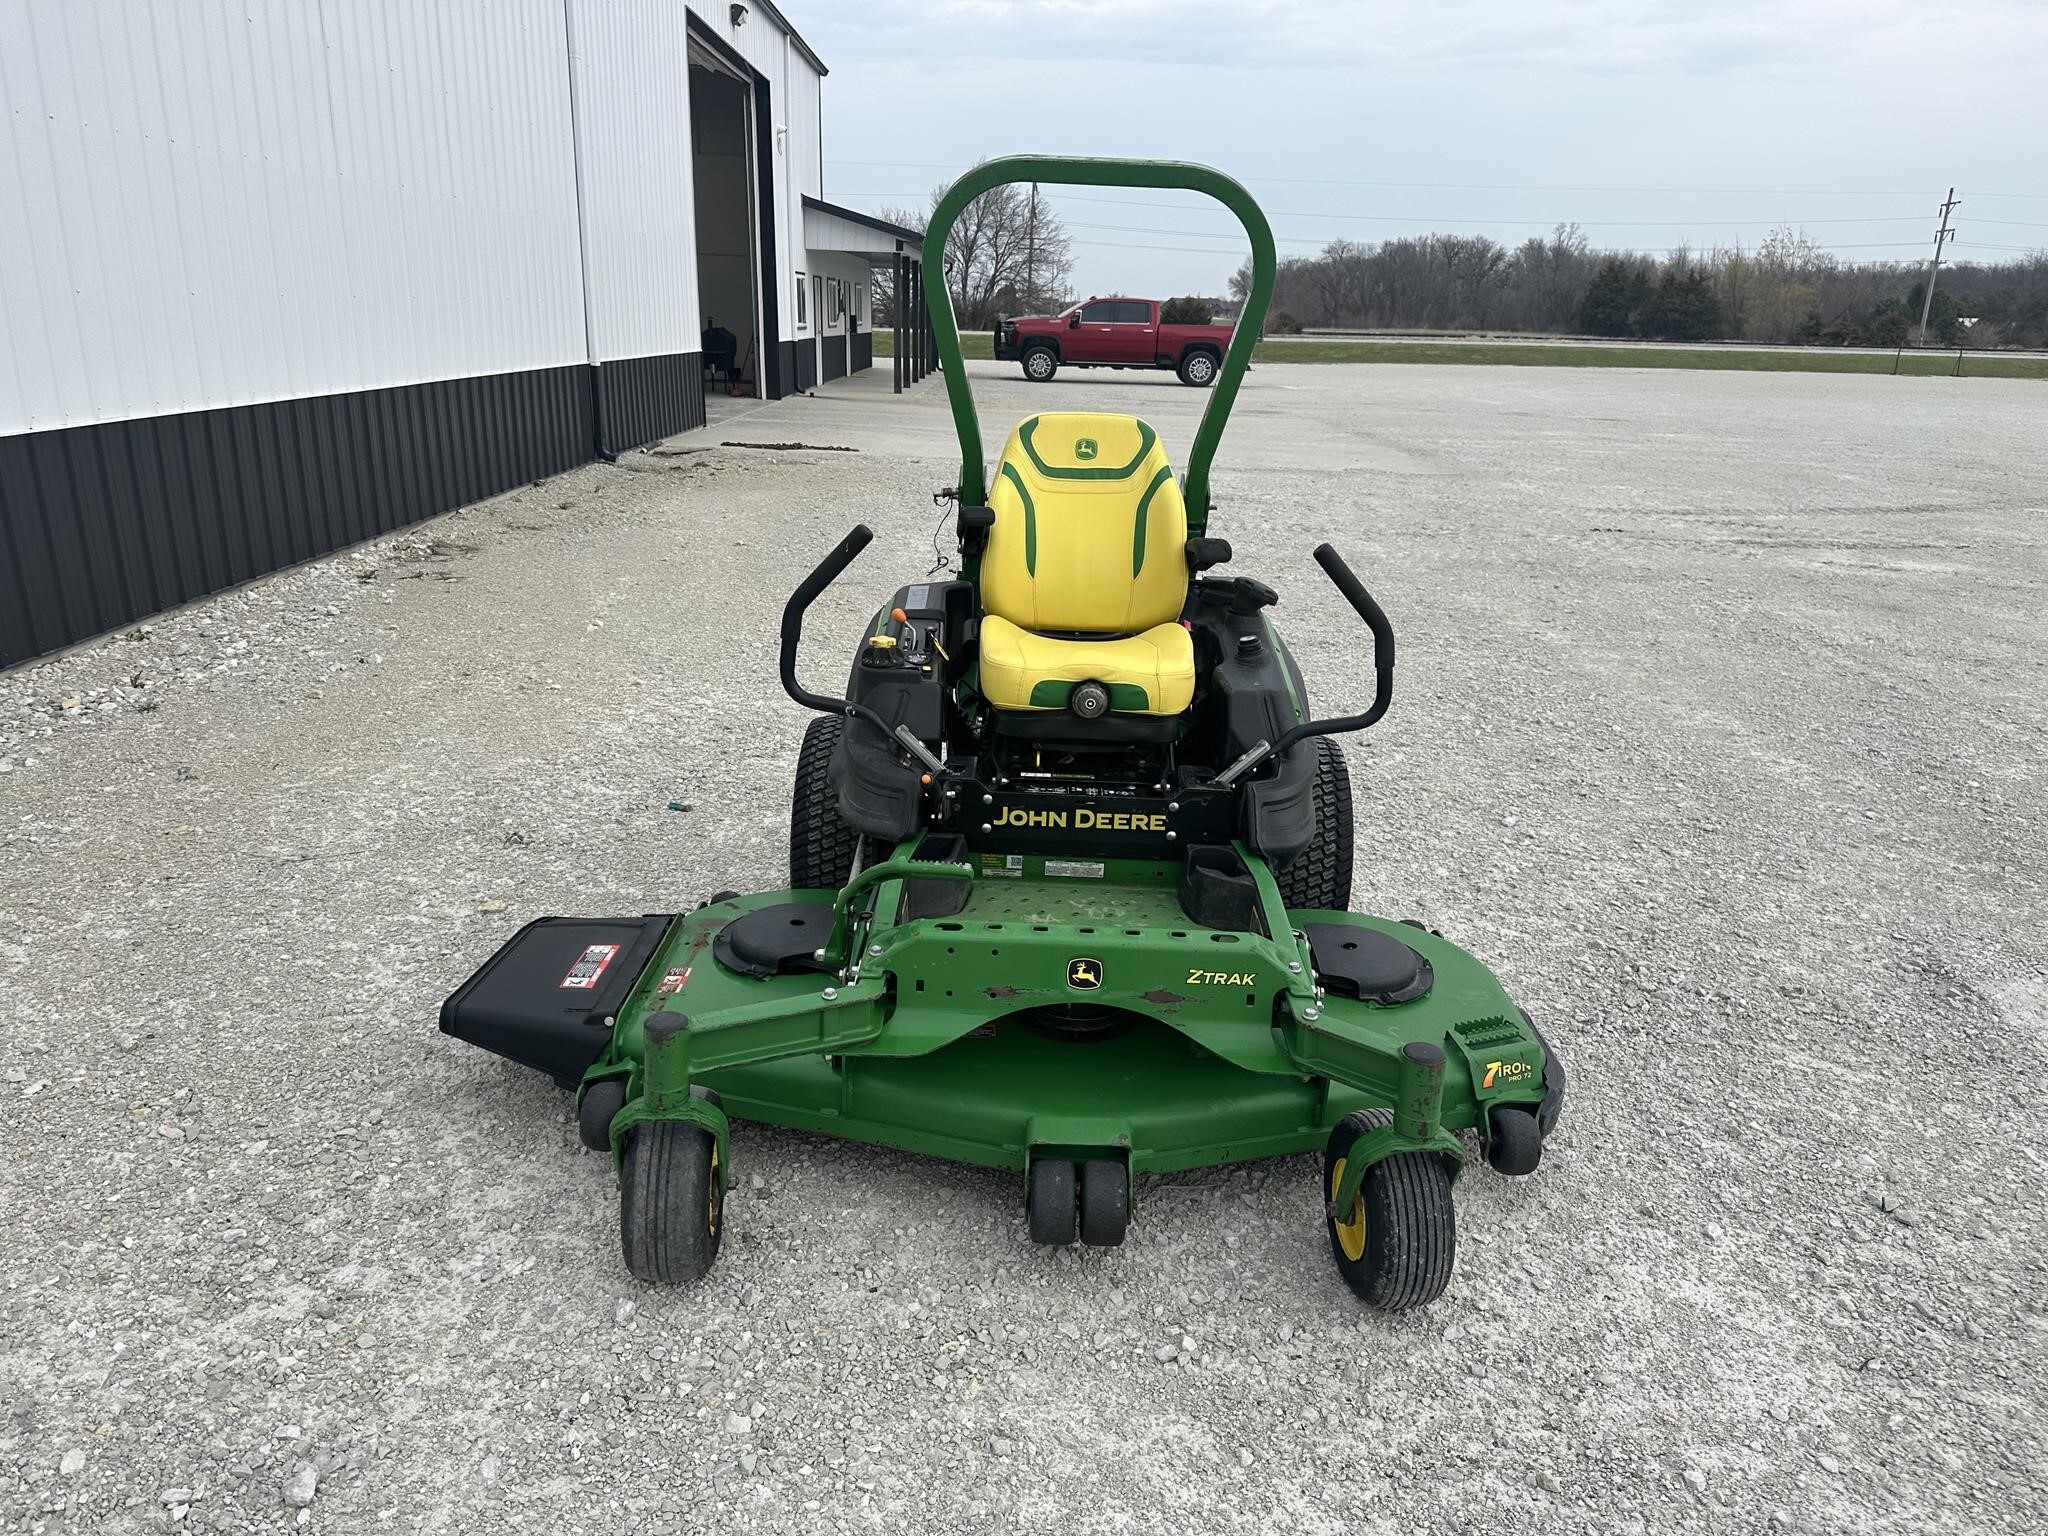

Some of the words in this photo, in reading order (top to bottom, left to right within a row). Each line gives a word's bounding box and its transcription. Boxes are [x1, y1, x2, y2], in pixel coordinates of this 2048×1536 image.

[993, 806, 1067, 827] JOHN
[1074, 808, 1167, 831] DEERE
[1186, 969, 1256, 986] ZTRAK
[1508, 1074, 1522, 1082] PRO
